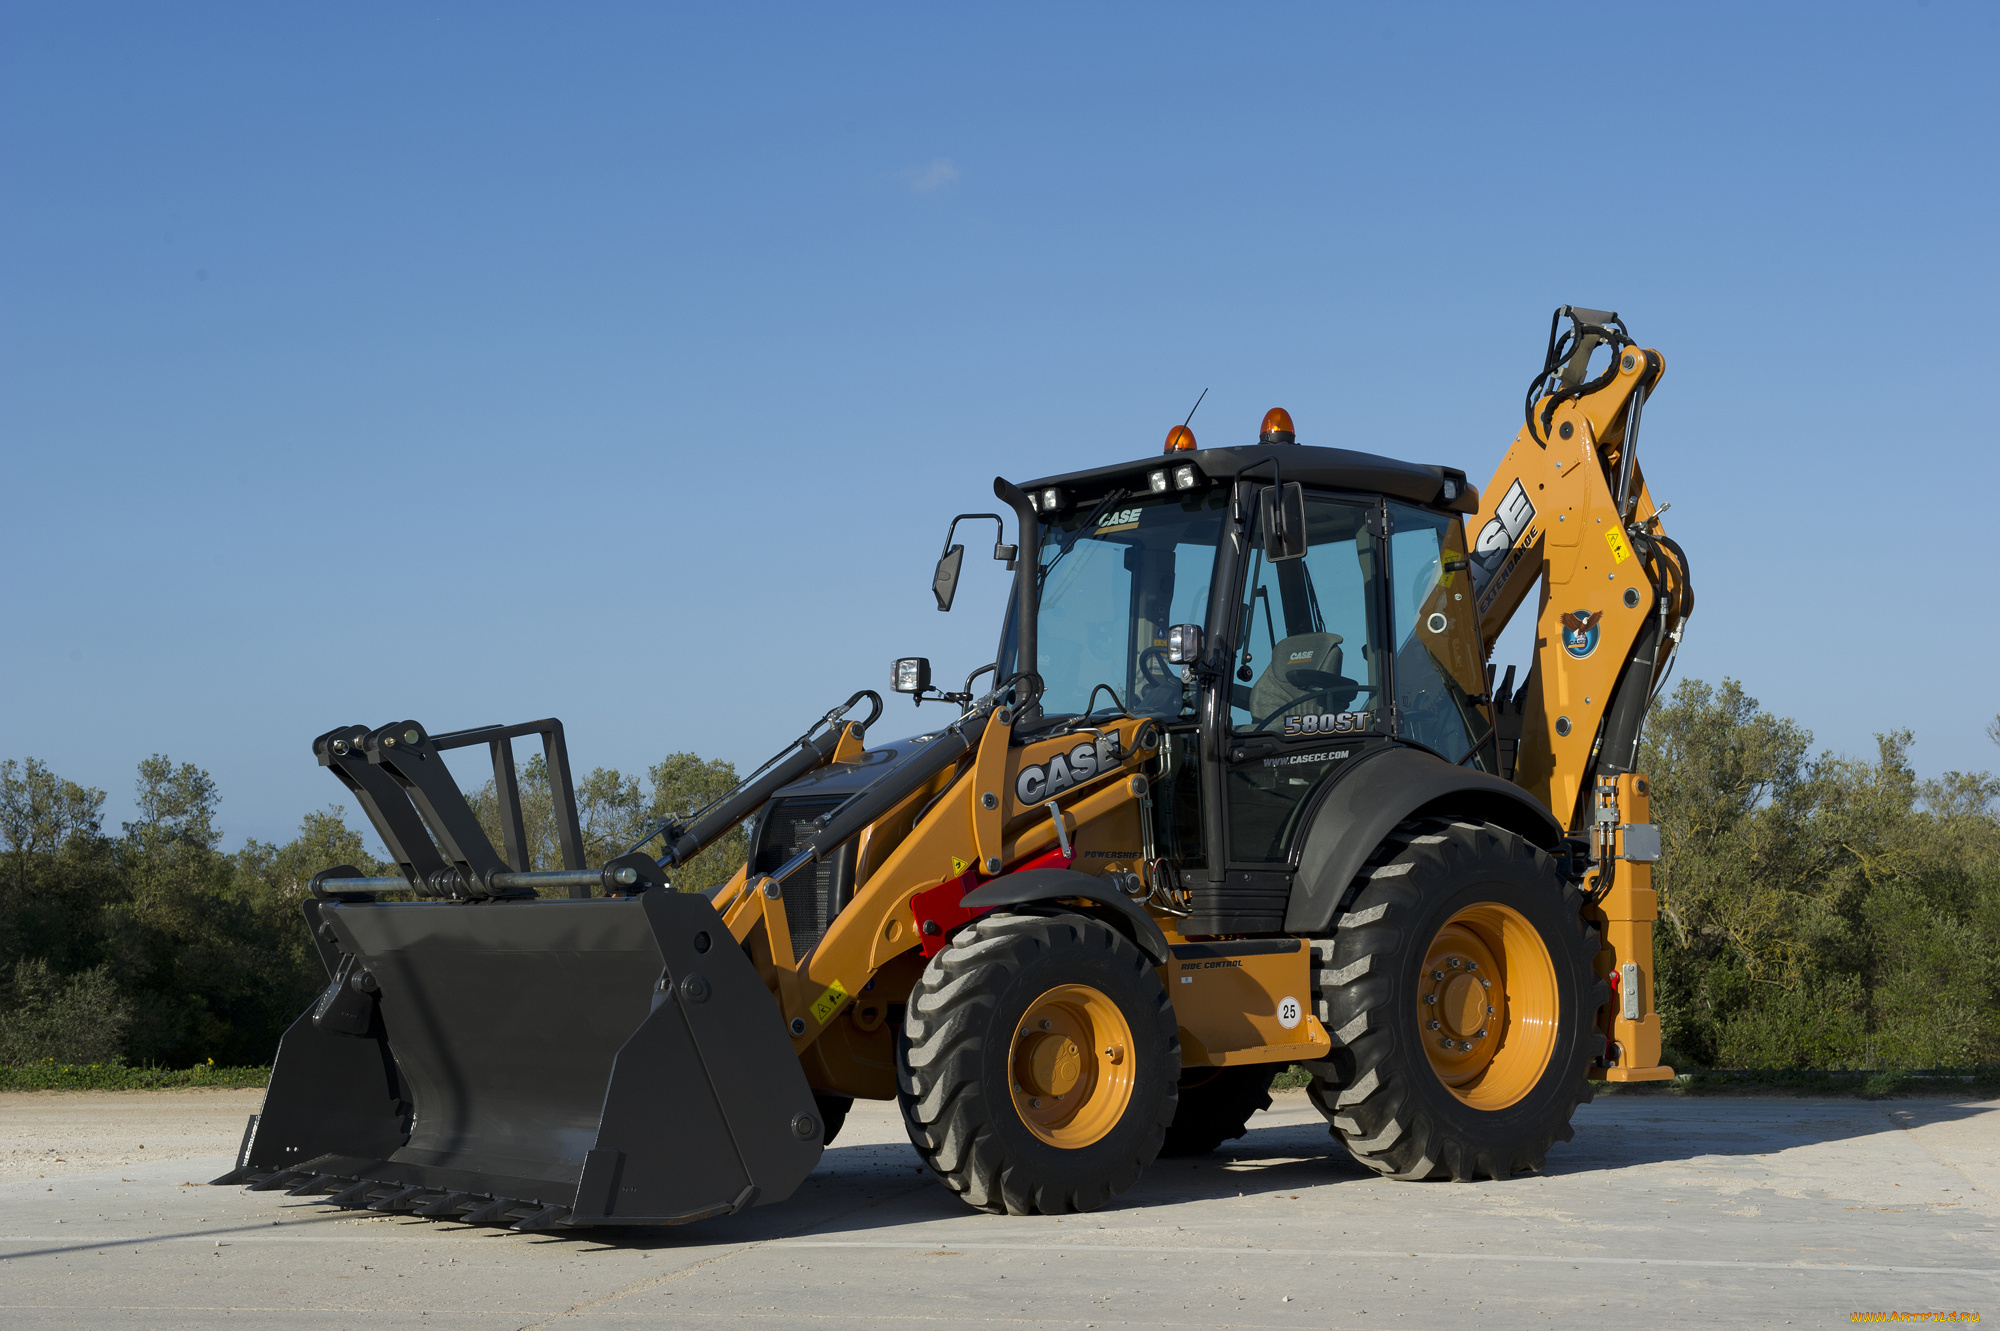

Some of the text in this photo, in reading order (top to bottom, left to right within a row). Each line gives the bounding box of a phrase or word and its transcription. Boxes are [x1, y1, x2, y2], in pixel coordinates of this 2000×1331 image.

[1098, 508, 1142, 527] CASE
[1469, 478, 1536, 599] ASE
[1480, 525, 1539, 615] EXTENDAHOE
[1290, 651, 1313, 660] CASE
[1285, 712, 1369, 736] 580ST
[1017, 730, 1121, 804] CASE
[1264, 750, 1349, 767] WWW.CASECE.COM
[1085, 851, 1143, 859] POWERSHIFT
[1181, 960, 1243, 971] RIDE CONTROL
[1283, 1004, 1296, 1019] 25
